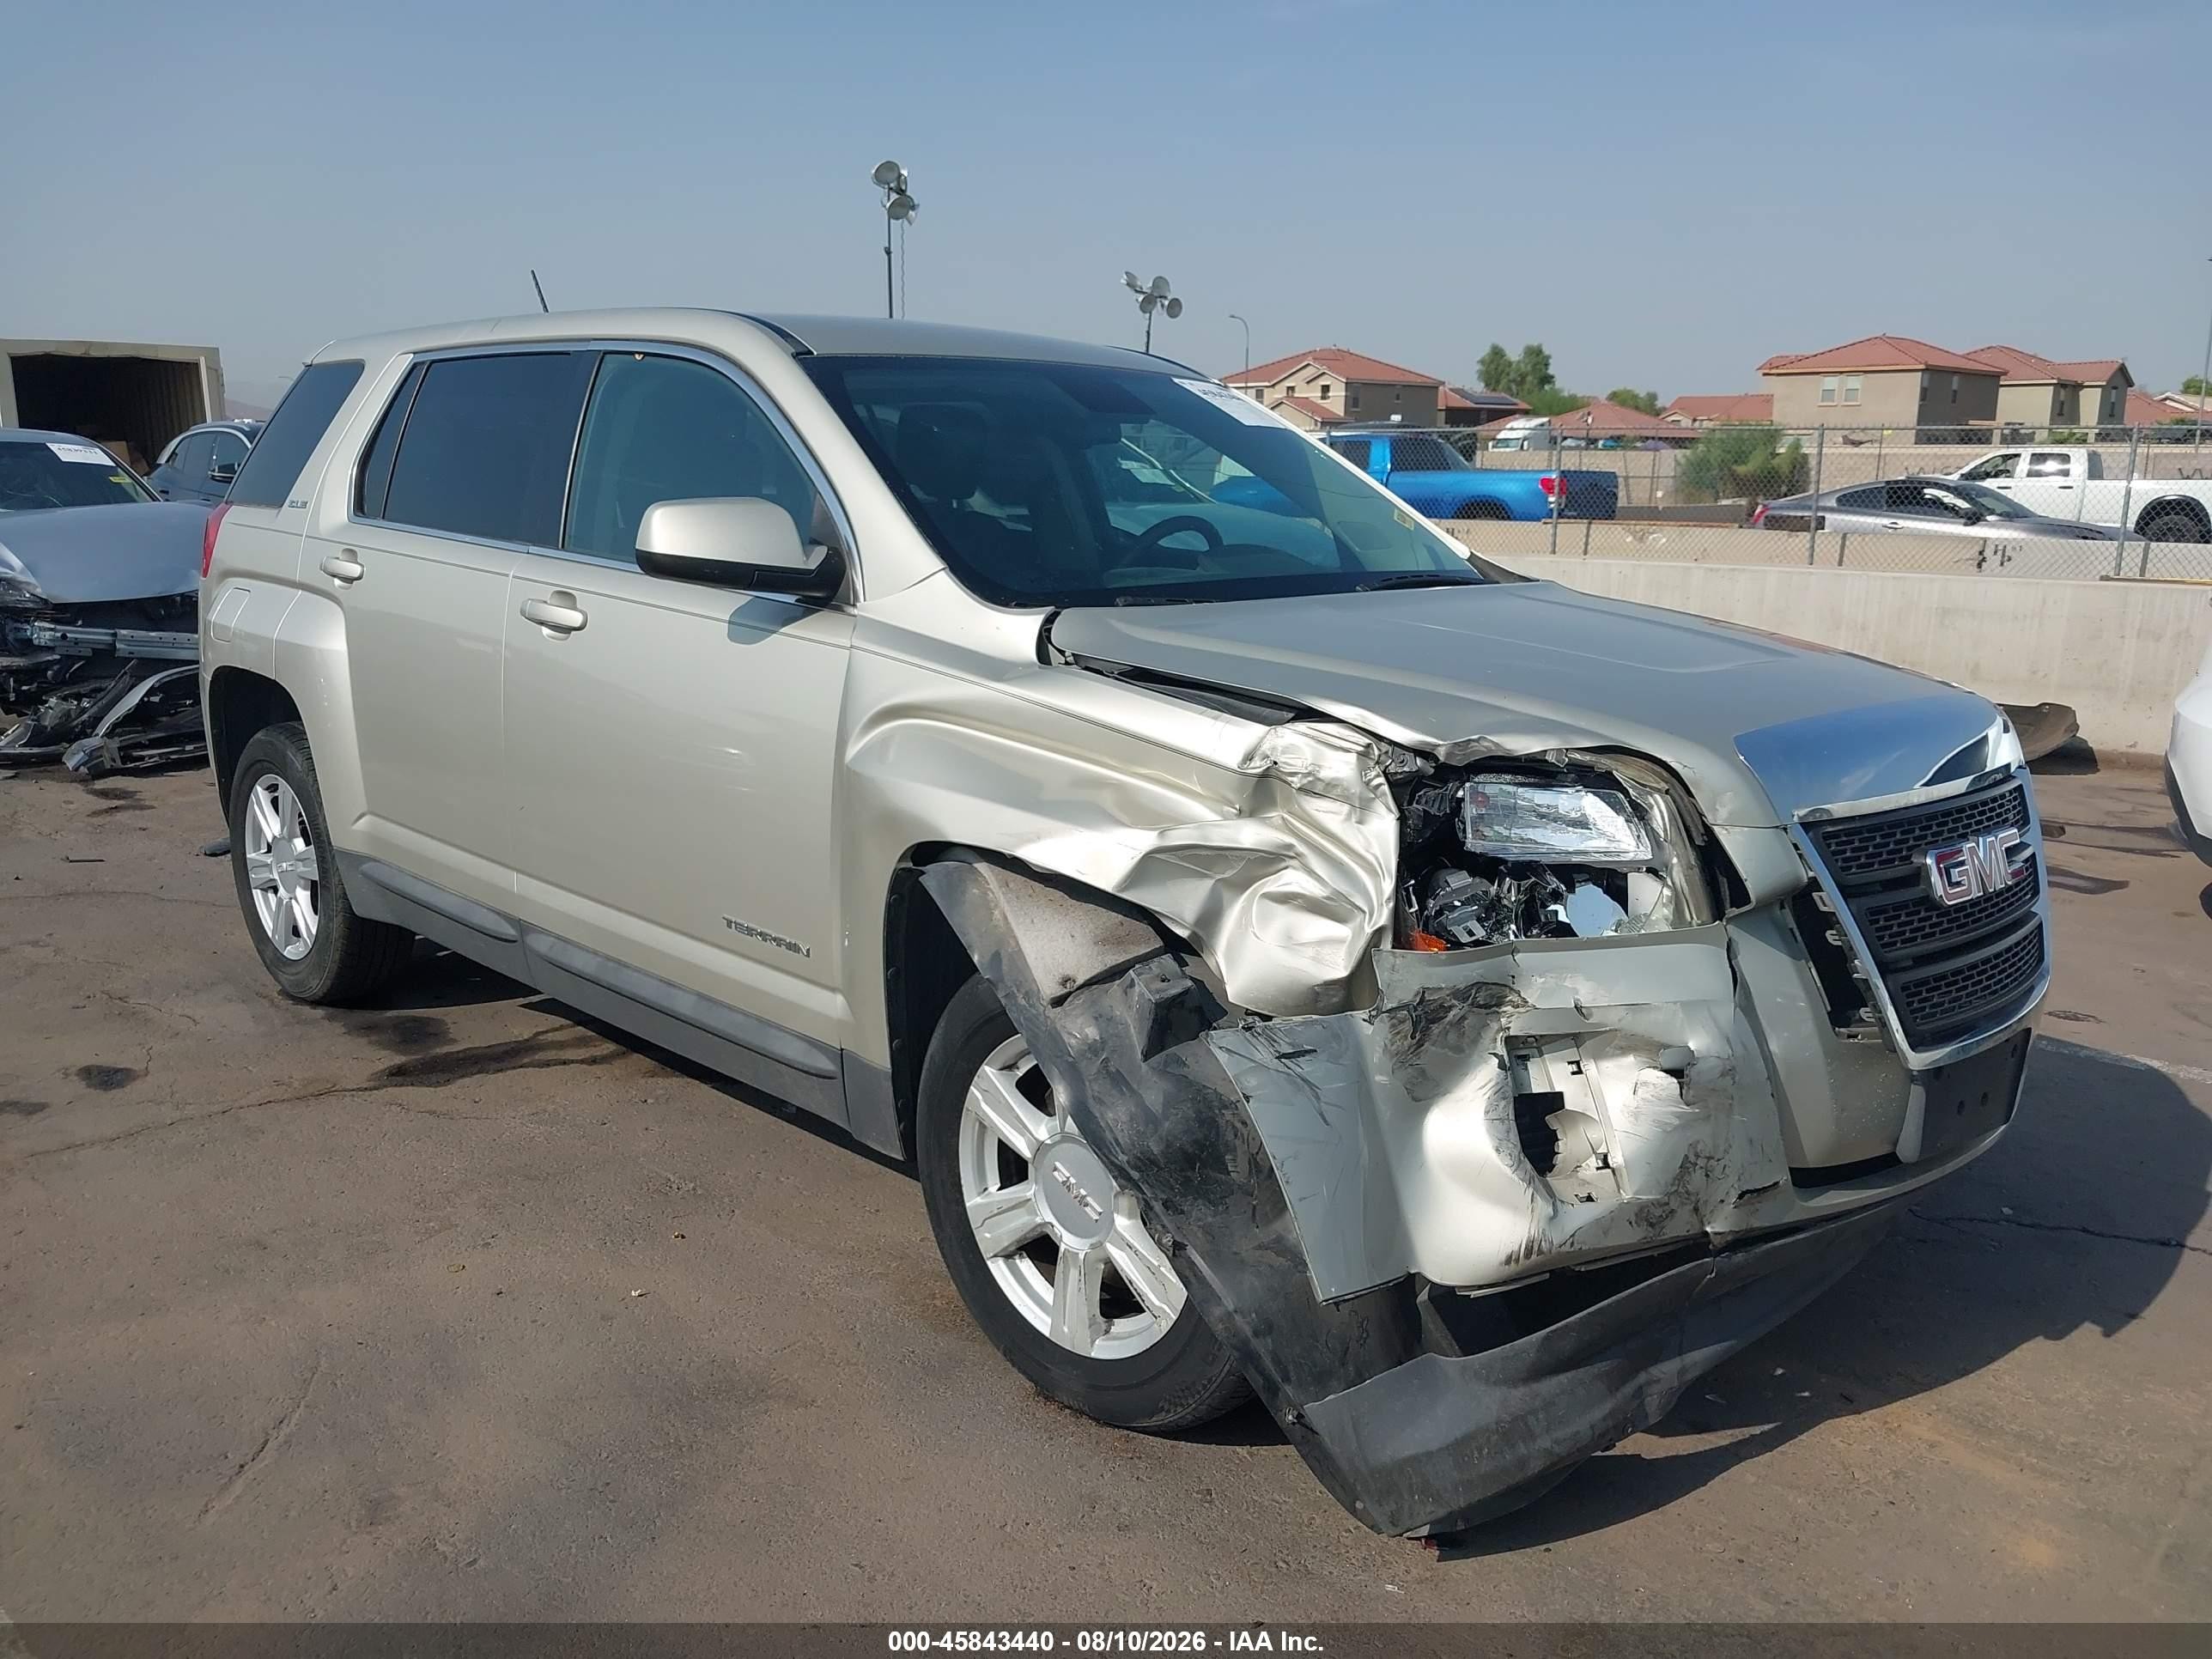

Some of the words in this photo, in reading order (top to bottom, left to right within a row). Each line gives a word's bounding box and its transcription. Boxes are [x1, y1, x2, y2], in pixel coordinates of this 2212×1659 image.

[1927, 826, 2026, 905] GMC
[722, 914, 811, 958] TERRAIN
[1053, 1161, 1103, 1223] GMC
